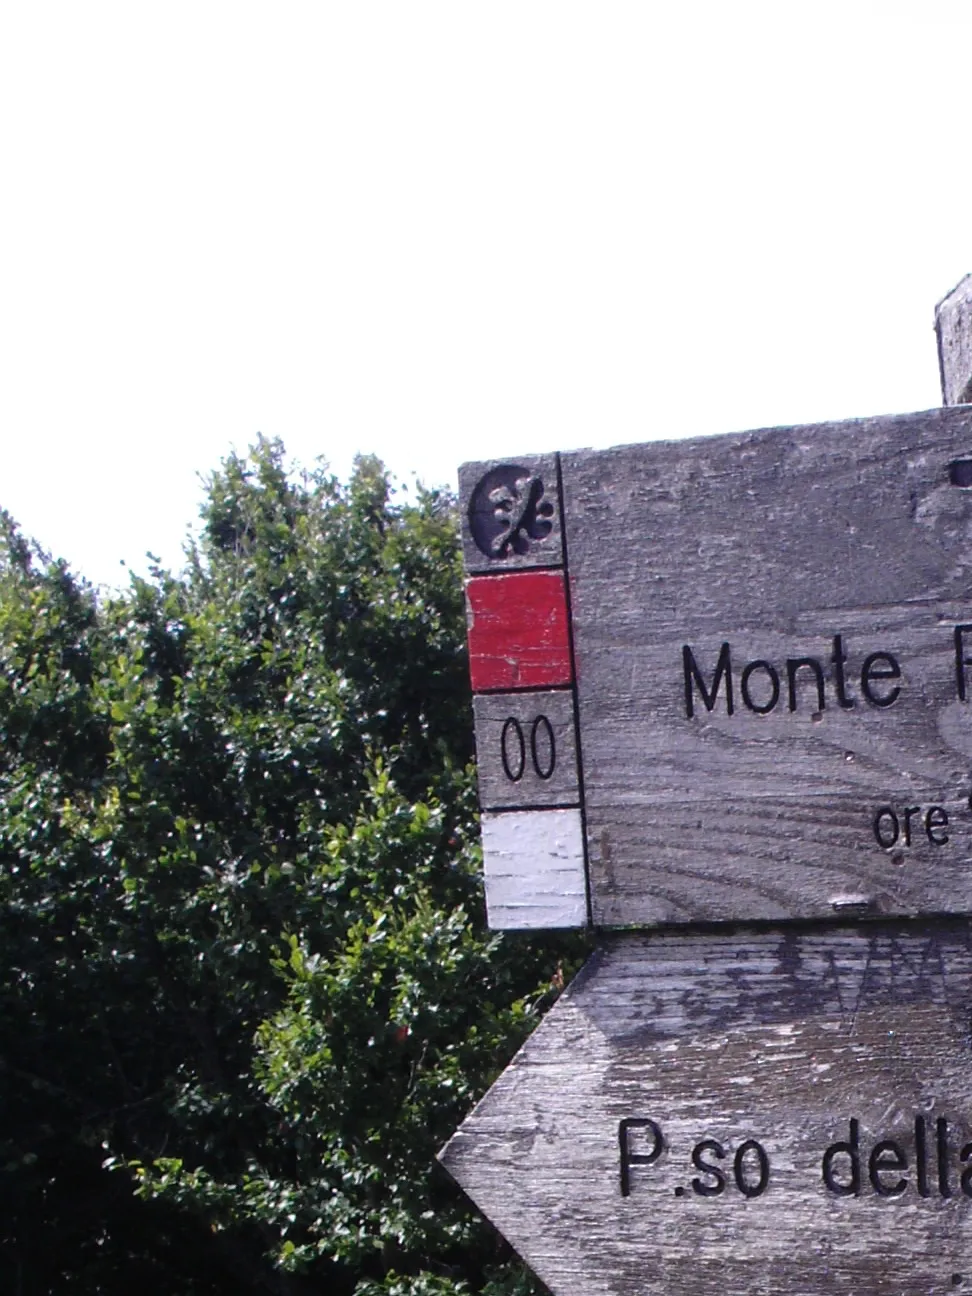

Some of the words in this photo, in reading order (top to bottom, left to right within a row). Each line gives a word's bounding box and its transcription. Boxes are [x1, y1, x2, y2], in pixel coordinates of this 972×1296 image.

[682, 634, 902, 718] Monte
[500, 714, 556, 783] 00
[873, 803, 950, 850] ore
[618, 1117, 770, 1198] P.so
